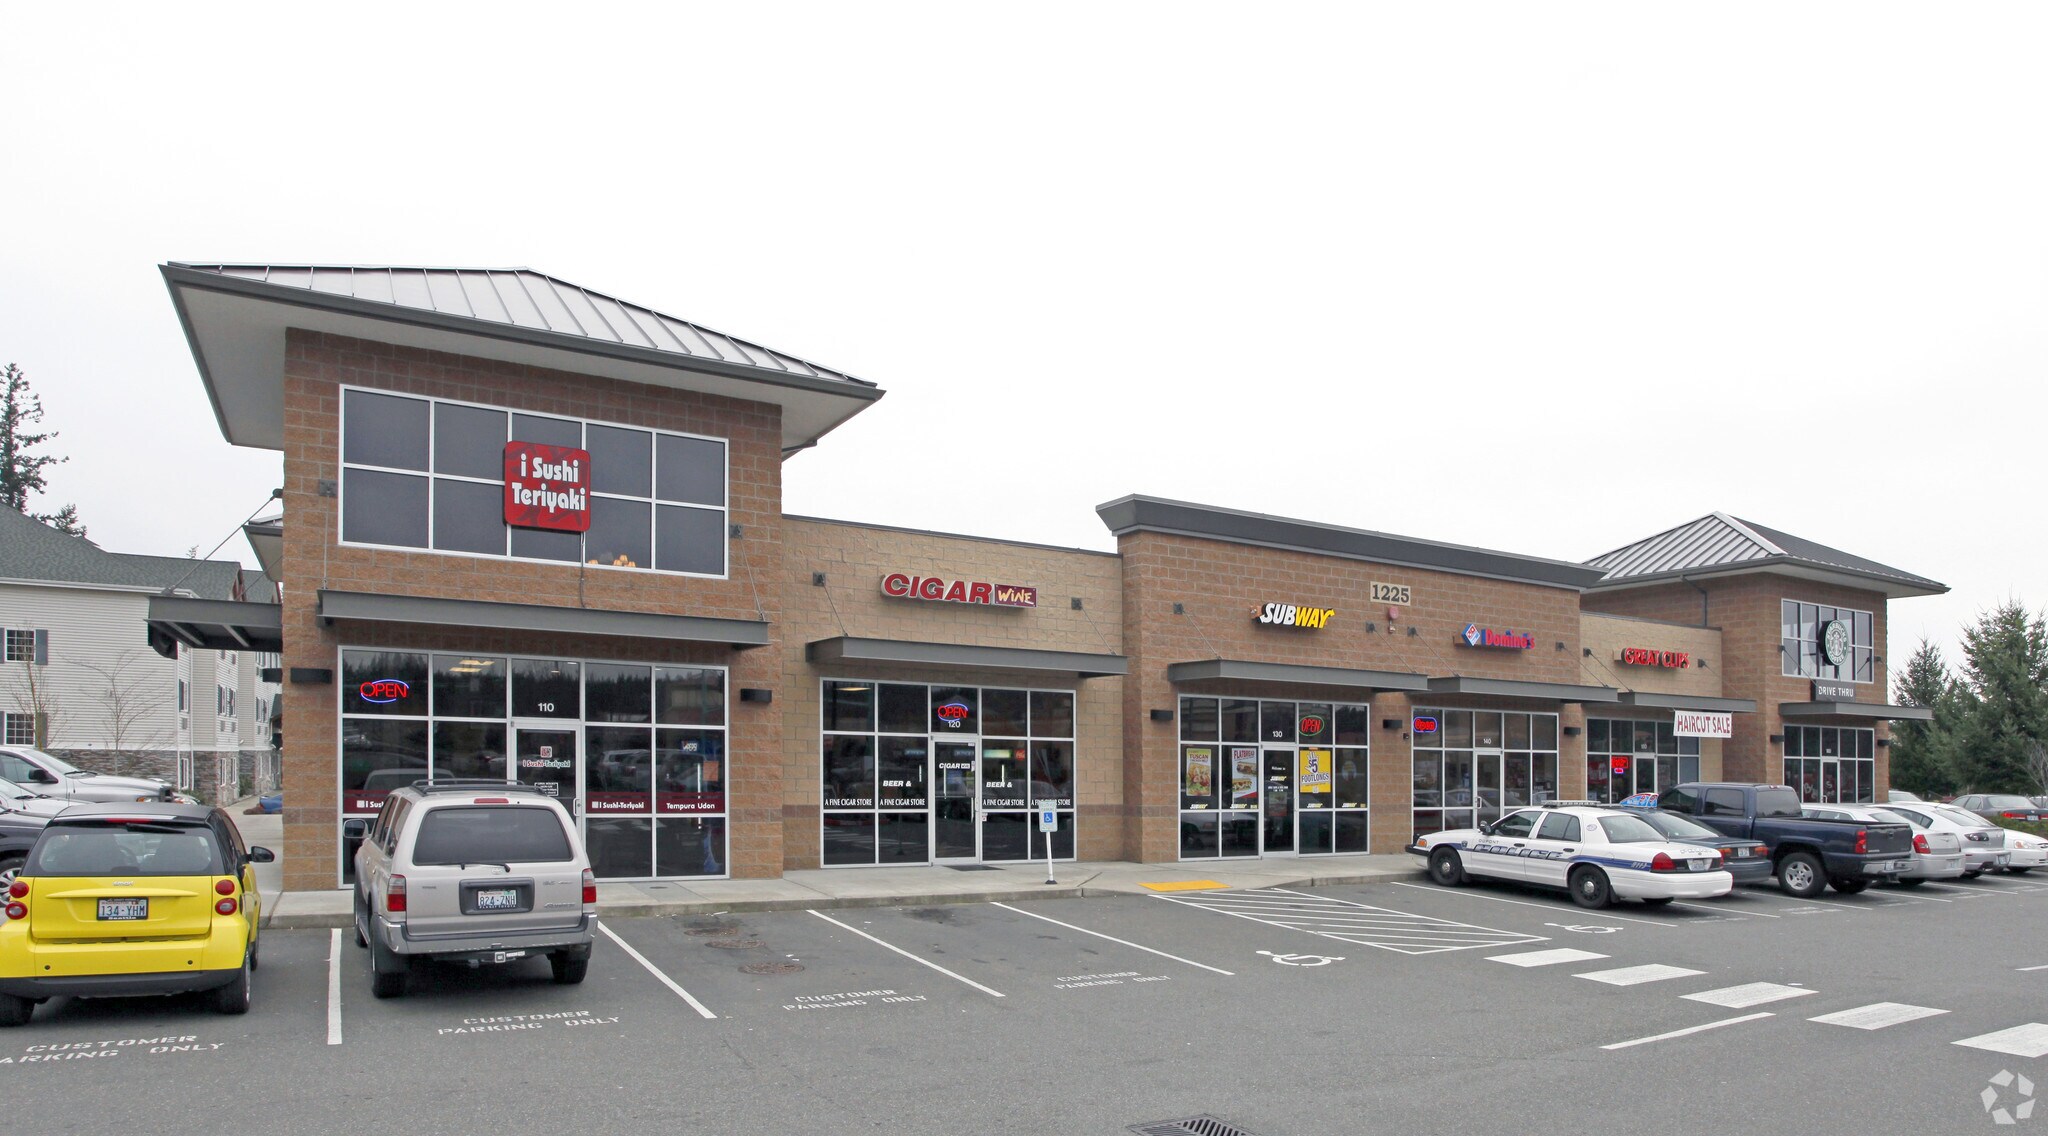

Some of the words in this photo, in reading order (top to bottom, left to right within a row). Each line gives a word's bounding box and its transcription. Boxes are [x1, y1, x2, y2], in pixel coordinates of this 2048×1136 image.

[520, 453, 527, 477] i
[532, 457, 579, 483] Sushi
[511, 482, 586, 513] Teriyaki
[883, 573, 993, 604] CIGAR
[1372, 584, 1410, 603] 1225
[1260, 602, 1335, 629] SUBWAY
[1484, 628, 1536, 649] Domino's
[1624, 647, 1660, 667] GREAT
[1661, 650, 1690, 669] CLIPS
[360, 681, 408, 698] OPEN
[1818, 686, 1837, 696] DRIVE
[1837, 687, 1854, 697] THRU
[537, 702, 555, 712] 110
[937, 705, 968, 718] OPEN
[947, 720, 961, 728] 120
[1301, 718, 1322, 733] OPEN
[1677, 715, 1711, 733] HAIRCUT
[1712, 716, 1731, 734] SALE
[1272, 730, 1283, 738] 130
[1301, 773, 1330, 783] FOOTLONGS
[602, 801, 645, 810] Sushi-Teriyaki
[666, 802, 696, 811] Tempura
[829, 798, 840, 806] FINE
[840, 798, 856, 806] CIGAR
[856, 798, 872, 806] STORE
[884, 798, 895, 806] FINE
[895, 798, 910, 806] CIGAR
[910, 798, 925, 806] STORE
[1473, 843, 1564, 860] POLICE
[479, 895, 516, 906] 824-ZNH
[101, 905, 146, 916] 134-YHM
[782, 999, 868, 1011] PARKING
[881, 995, 927, 1003] ONLY
[794, 989, 898, 1003] CUSTOMER
[463, 1010, 590, 1025] CUSTOMER
[437, 1022, 543, 1035] PARKING
[564, 1016, 620, 1026] ONLY
[25, 1035, 197, 1052] CUSTOMER
[0, 1049, 119, 1064] ARKING
[149, 1042, 225, 1054] ONLY
